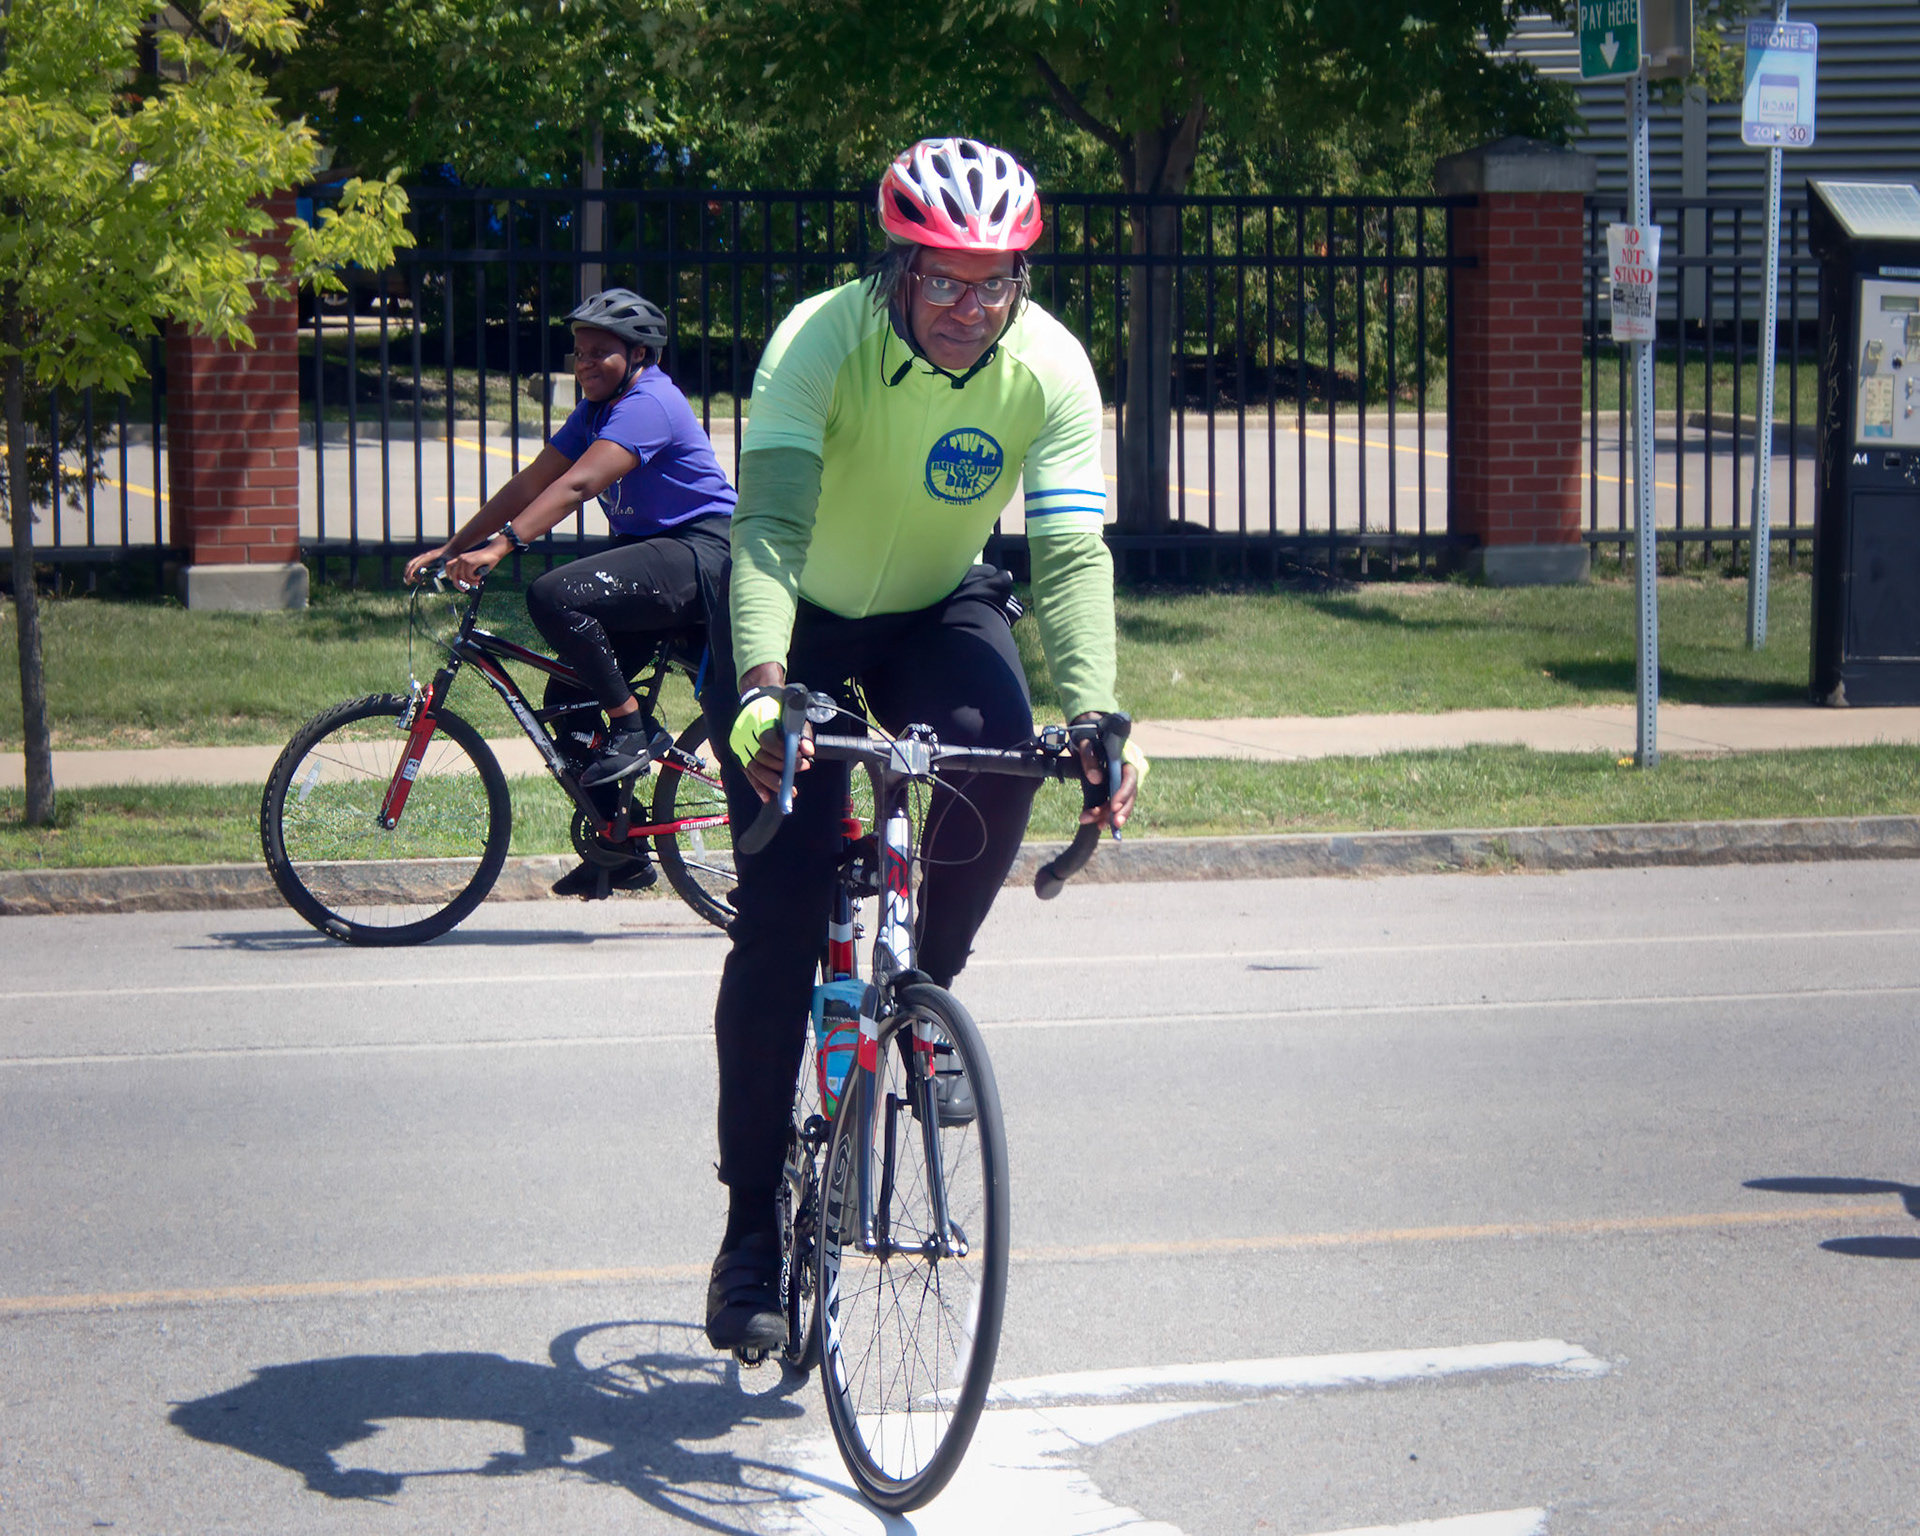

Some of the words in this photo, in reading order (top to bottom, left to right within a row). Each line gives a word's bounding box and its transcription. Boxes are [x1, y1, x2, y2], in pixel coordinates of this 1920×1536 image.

[1581, 4, 1602, 31] PAY
[1608, 0, 1637, 27] HERE
[1750, 32, 1799, 49] PHONE
[1789, 127, 1806, 141] 30
[1625, 228, 1640, 245] DO
[1622, 248, 1645, 265] NOT
[1614, 265, 1653, 284] STAND
[1852, 452, 1868, 466] A4
